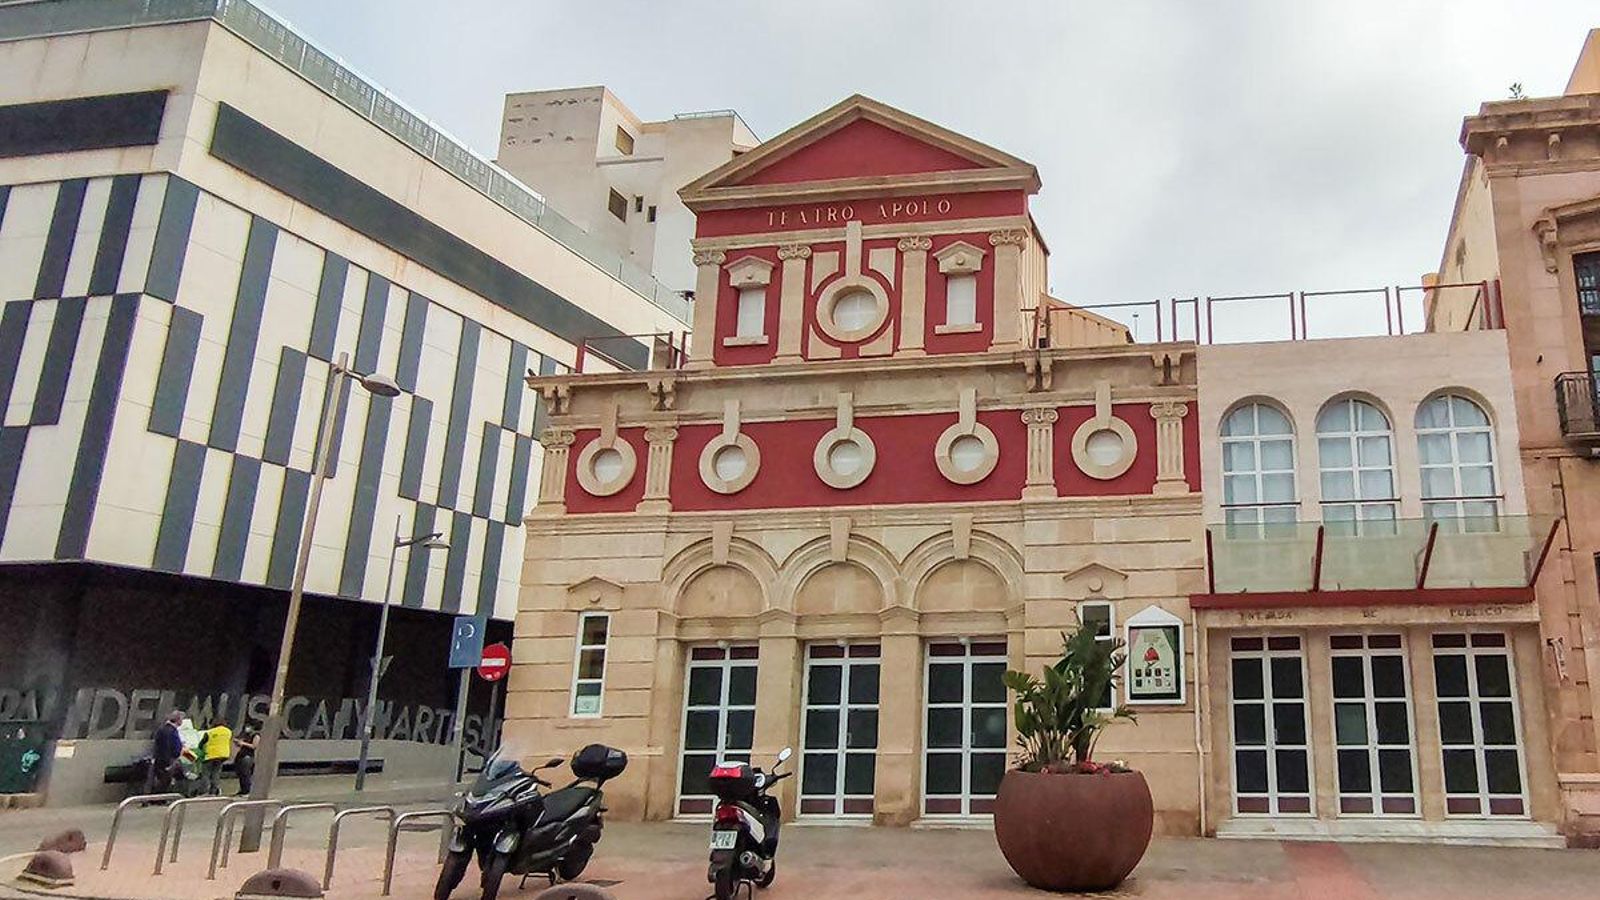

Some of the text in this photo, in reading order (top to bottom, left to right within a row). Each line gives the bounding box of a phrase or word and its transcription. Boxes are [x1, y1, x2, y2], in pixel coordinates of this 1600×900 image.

[767, 199, 951, 226] TEATRO APOLO
[186, 692, 332, 740] MUSCA
